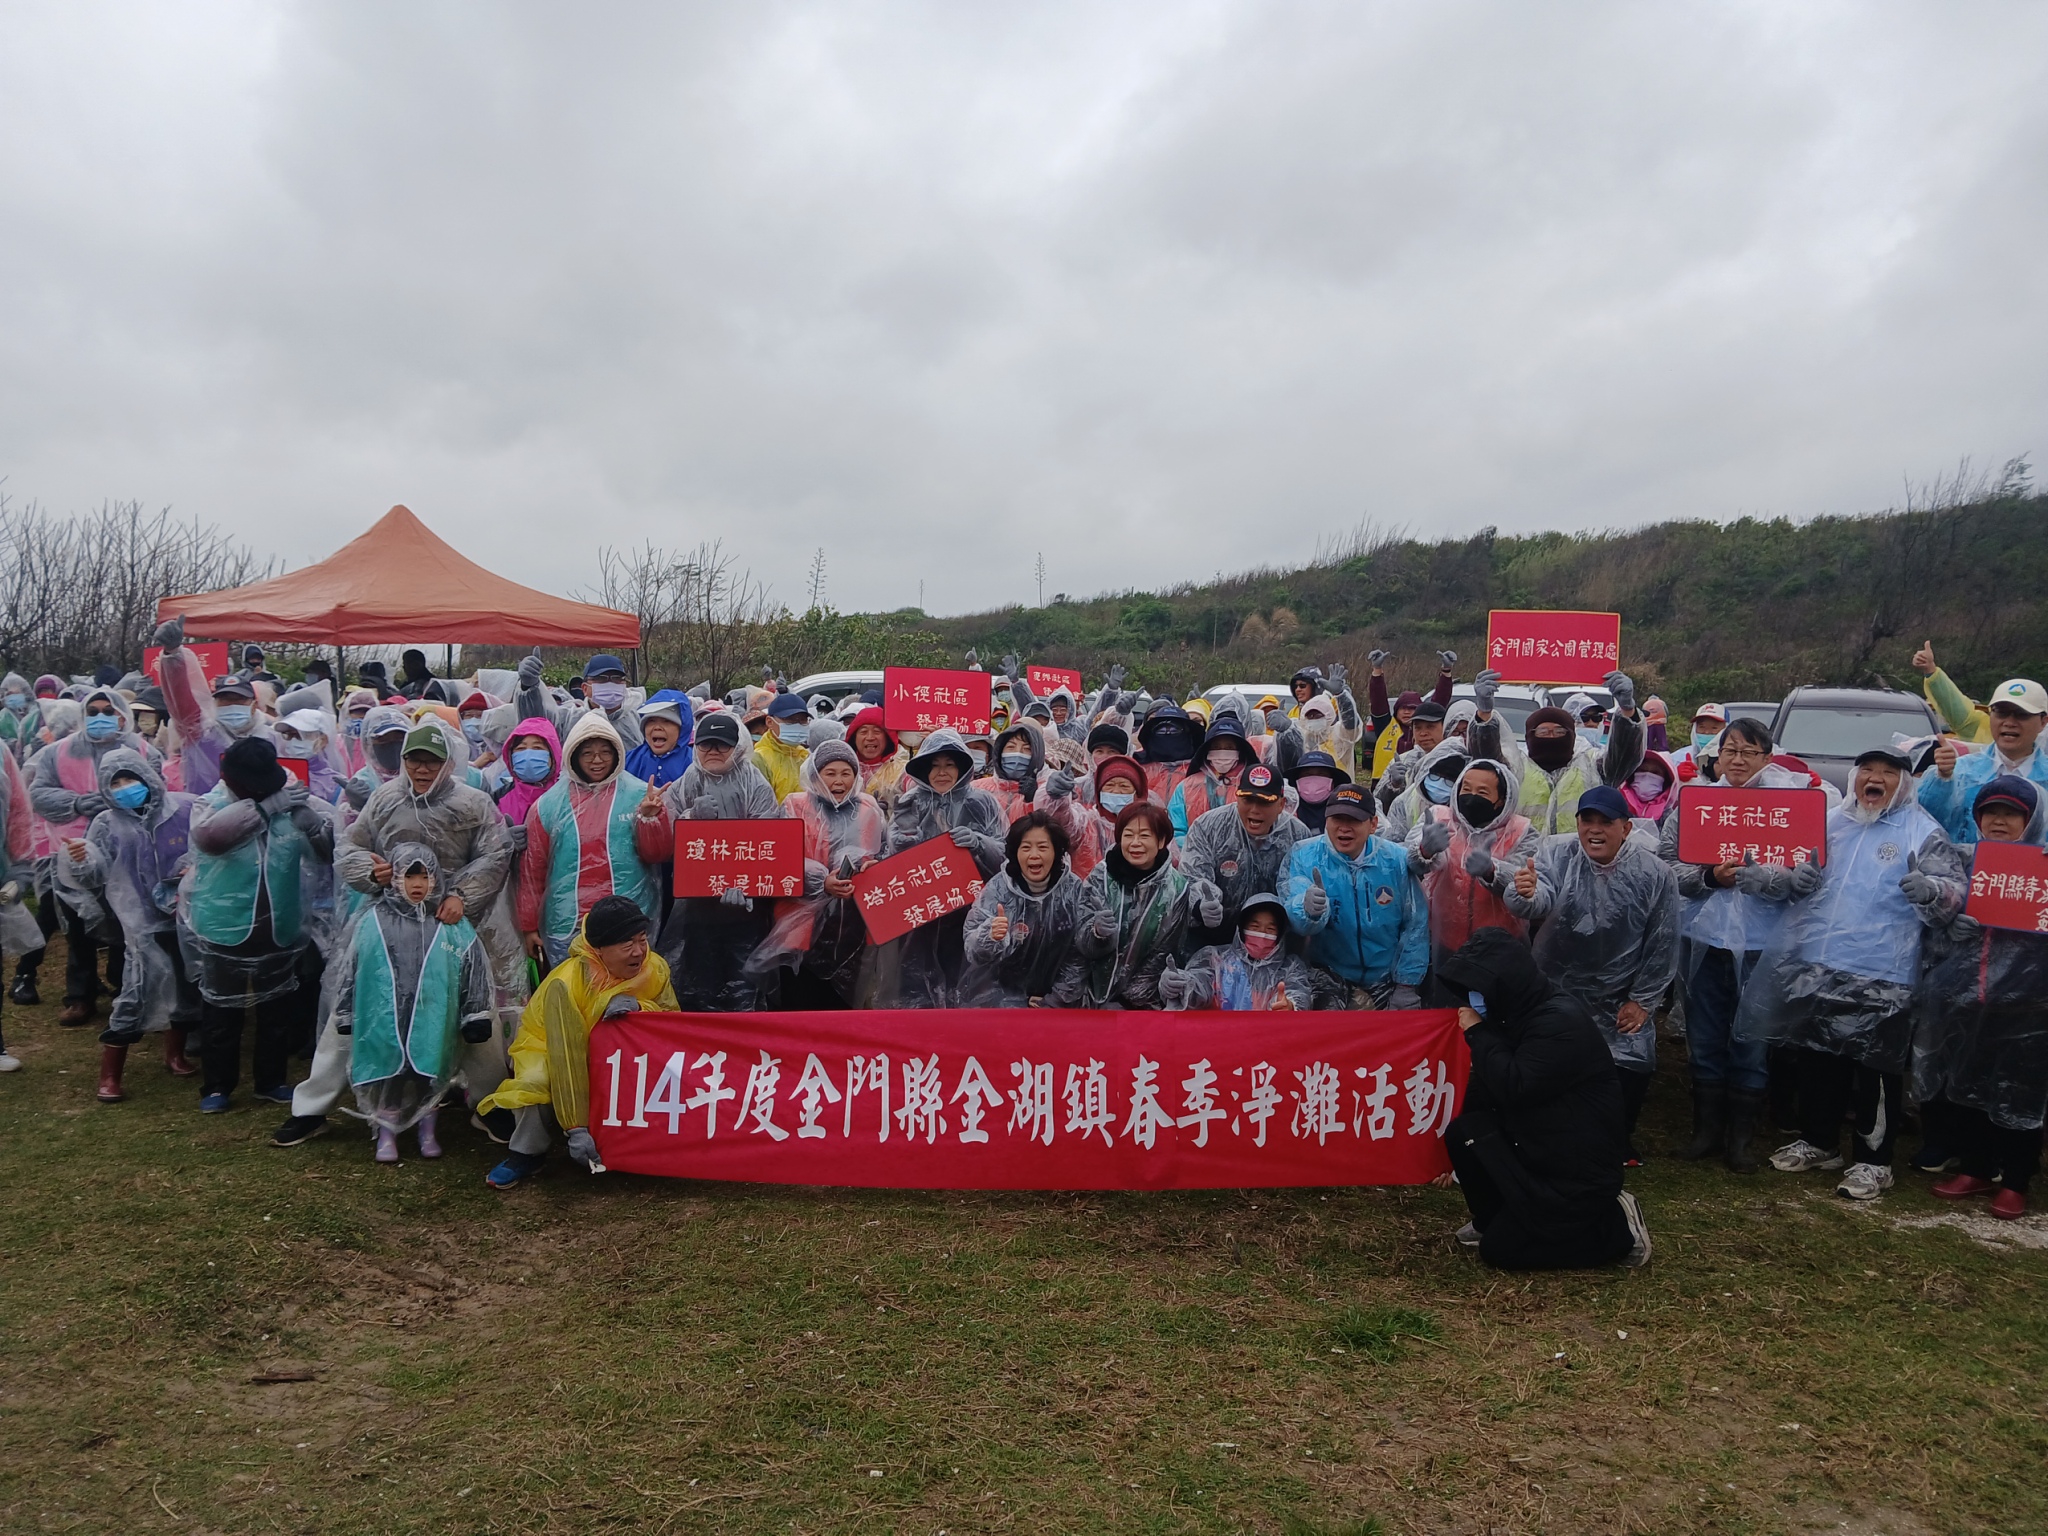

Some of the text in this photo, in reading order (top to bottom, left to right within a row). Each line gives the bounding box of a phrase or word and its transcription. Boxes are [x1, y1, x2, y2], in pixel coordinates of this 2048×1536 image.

[1490, 637, 1617, 660] 金門國家公園管理處
[892, 683, 969, 706] 小徑社區
[1694, 804, 1791, 828] 下莊社區
[686, 838, 777, 861] 瓊林社區
[708, 874, 801, 897] 發展協會
[863, 856, 952, 909] 塔后社區
[602, 1048, 1456, 1150] 114年度金門縣金湖鎮春季淨灘活動
